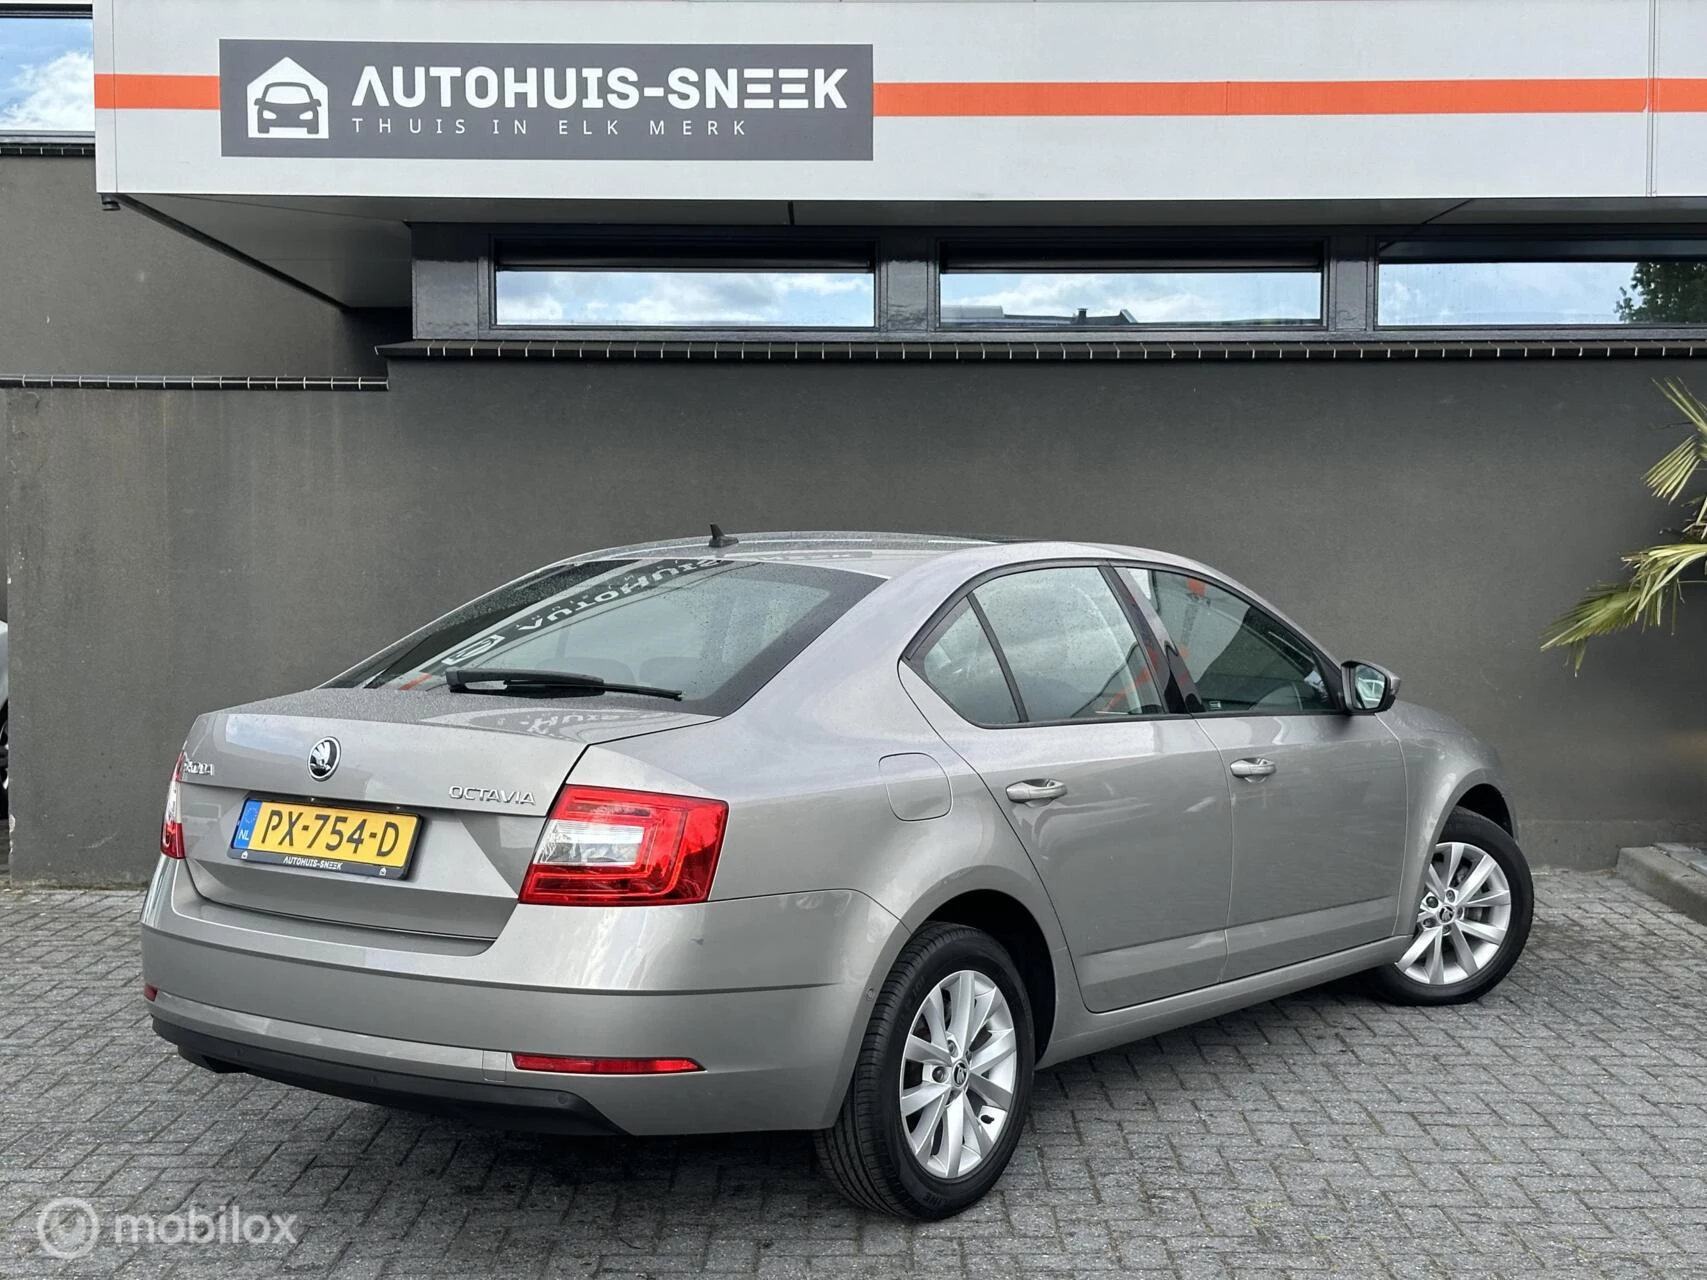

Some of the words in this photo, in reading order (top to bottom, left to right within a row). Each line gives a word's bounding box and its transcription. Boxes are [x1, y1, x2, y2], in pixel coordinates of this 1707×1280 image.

[351, 65, 848, 109] AUTOHUIS-SNEEK
[351, 117, 466, 134] THUIS
[492, 119, 528, 135] IN
[558, 119, 619, 135] ELK
[649, 120, 745, 136] MERK
[448, 785, 536, 806] OCTAVIA
[238, 829, 250, 841] NL
[261, 809, 400, 857] PX-754-D
[283, 856, 344, 871] AUTOHUIS-SNEEK
